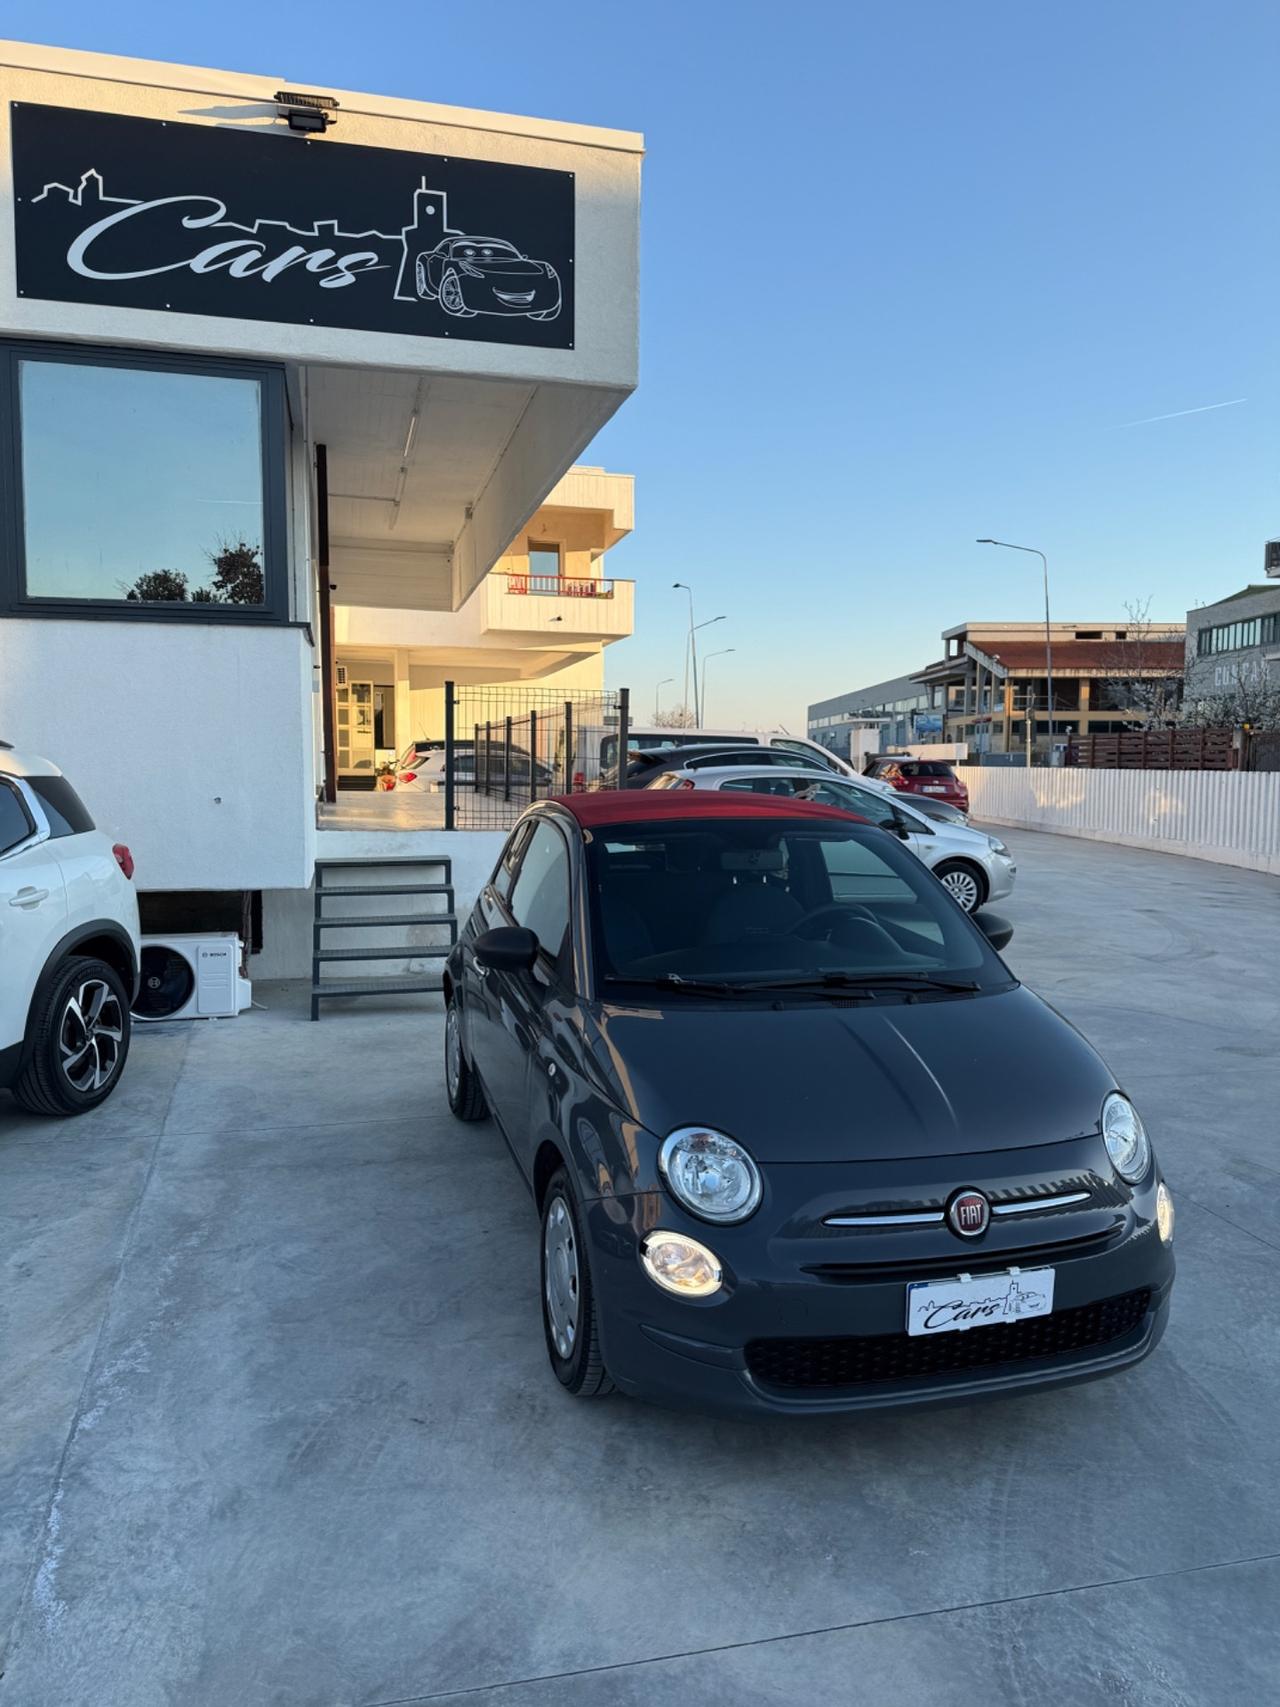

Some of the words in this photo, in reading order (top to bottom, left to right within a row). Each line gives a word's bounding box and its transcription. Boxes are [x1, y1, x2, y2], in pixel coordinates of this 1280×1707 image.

[66, 195, 392, 288] Cars
[960, 1204, 982, 1226] FIAT
[923, 1299, 1000, 1329] Cars
